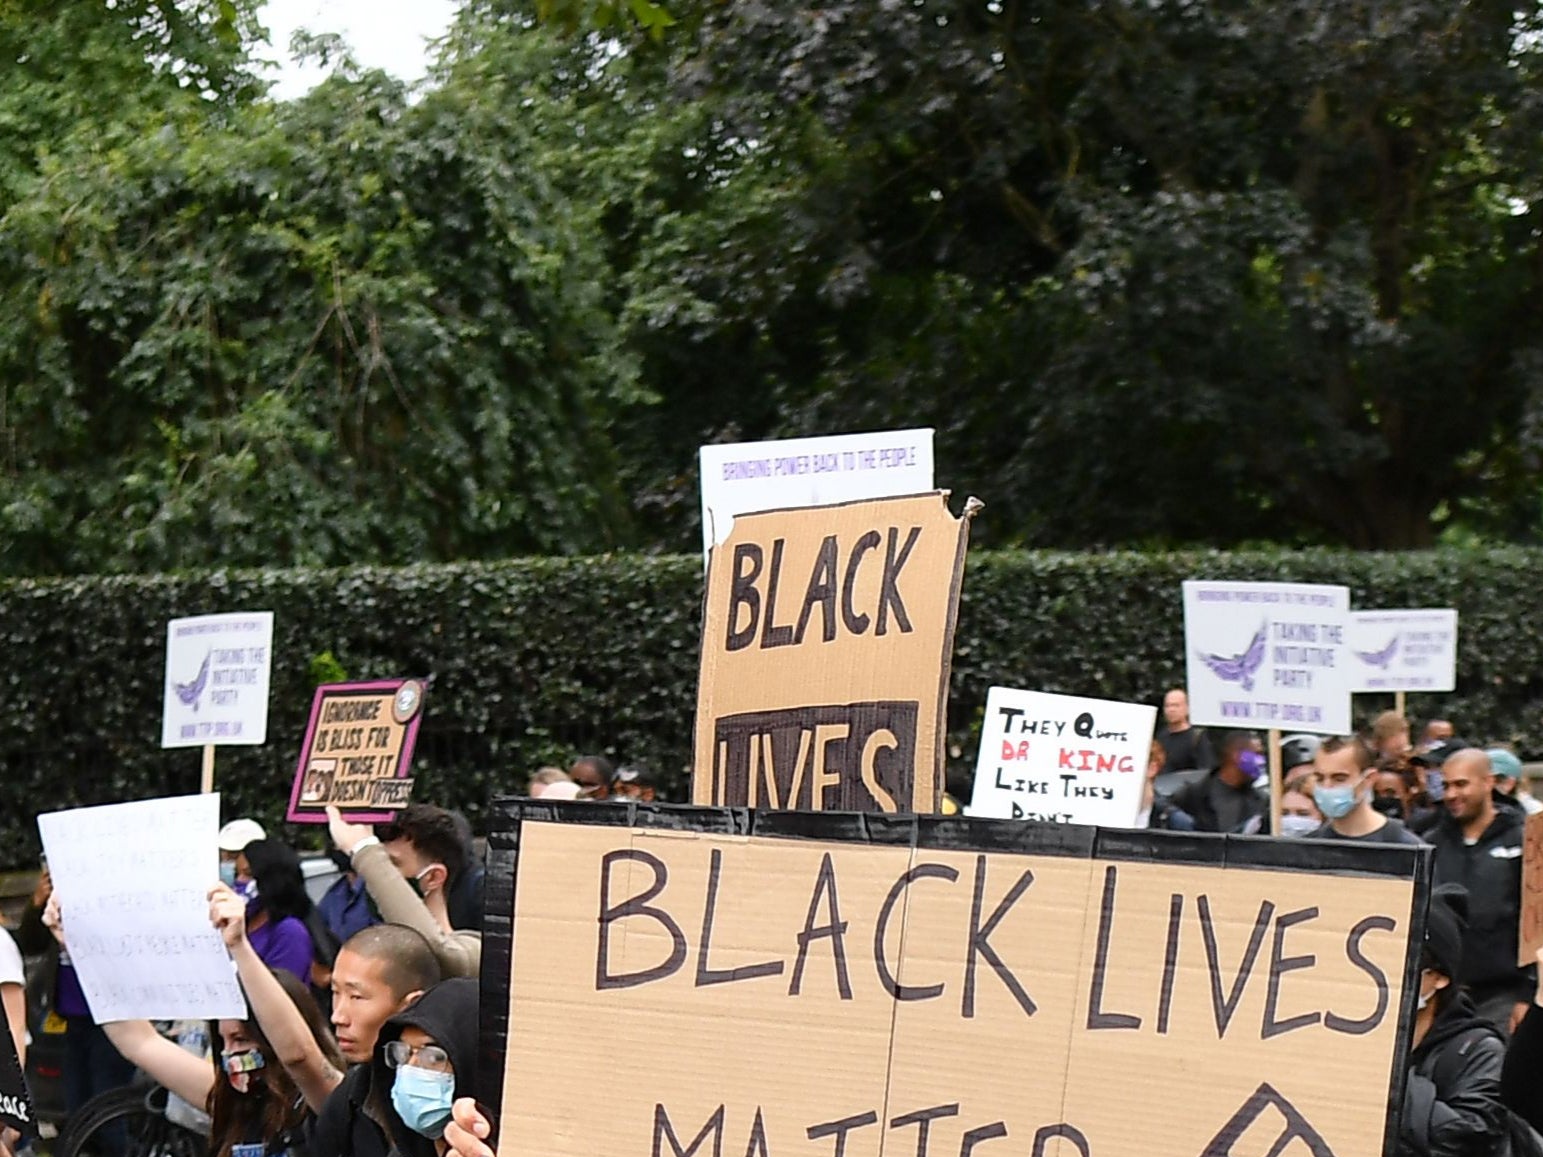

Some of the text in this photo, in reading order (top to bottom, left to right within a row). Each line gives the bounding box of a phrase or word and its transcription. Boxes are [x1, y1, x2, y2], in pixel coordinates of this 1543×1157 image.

[775, 456, 809, 476] POWER
[813, 453, 838, 473] BACK
[842, 452, 854, 470] TO
[858, 449, 876, 469] THE
[880, 446, 916, 467] PEOPLE
[725, 526, 922, 652] BLACK
[1273, 622, 1343, 644] TAKING THE
[1274, 669, 1313, 688] PARTY
[315, 726, 391, 752] IS BLISS FOR
[999, 707, 1128, 742] THEY QUOTE
[341, 754, 395, 776] THOSE IT
[1001, 739, 1134, 773] DR KING
[995, 767, 1114, 800] LIKE THEY
[596, 849, 1396, 1039] BLACK LIVES
